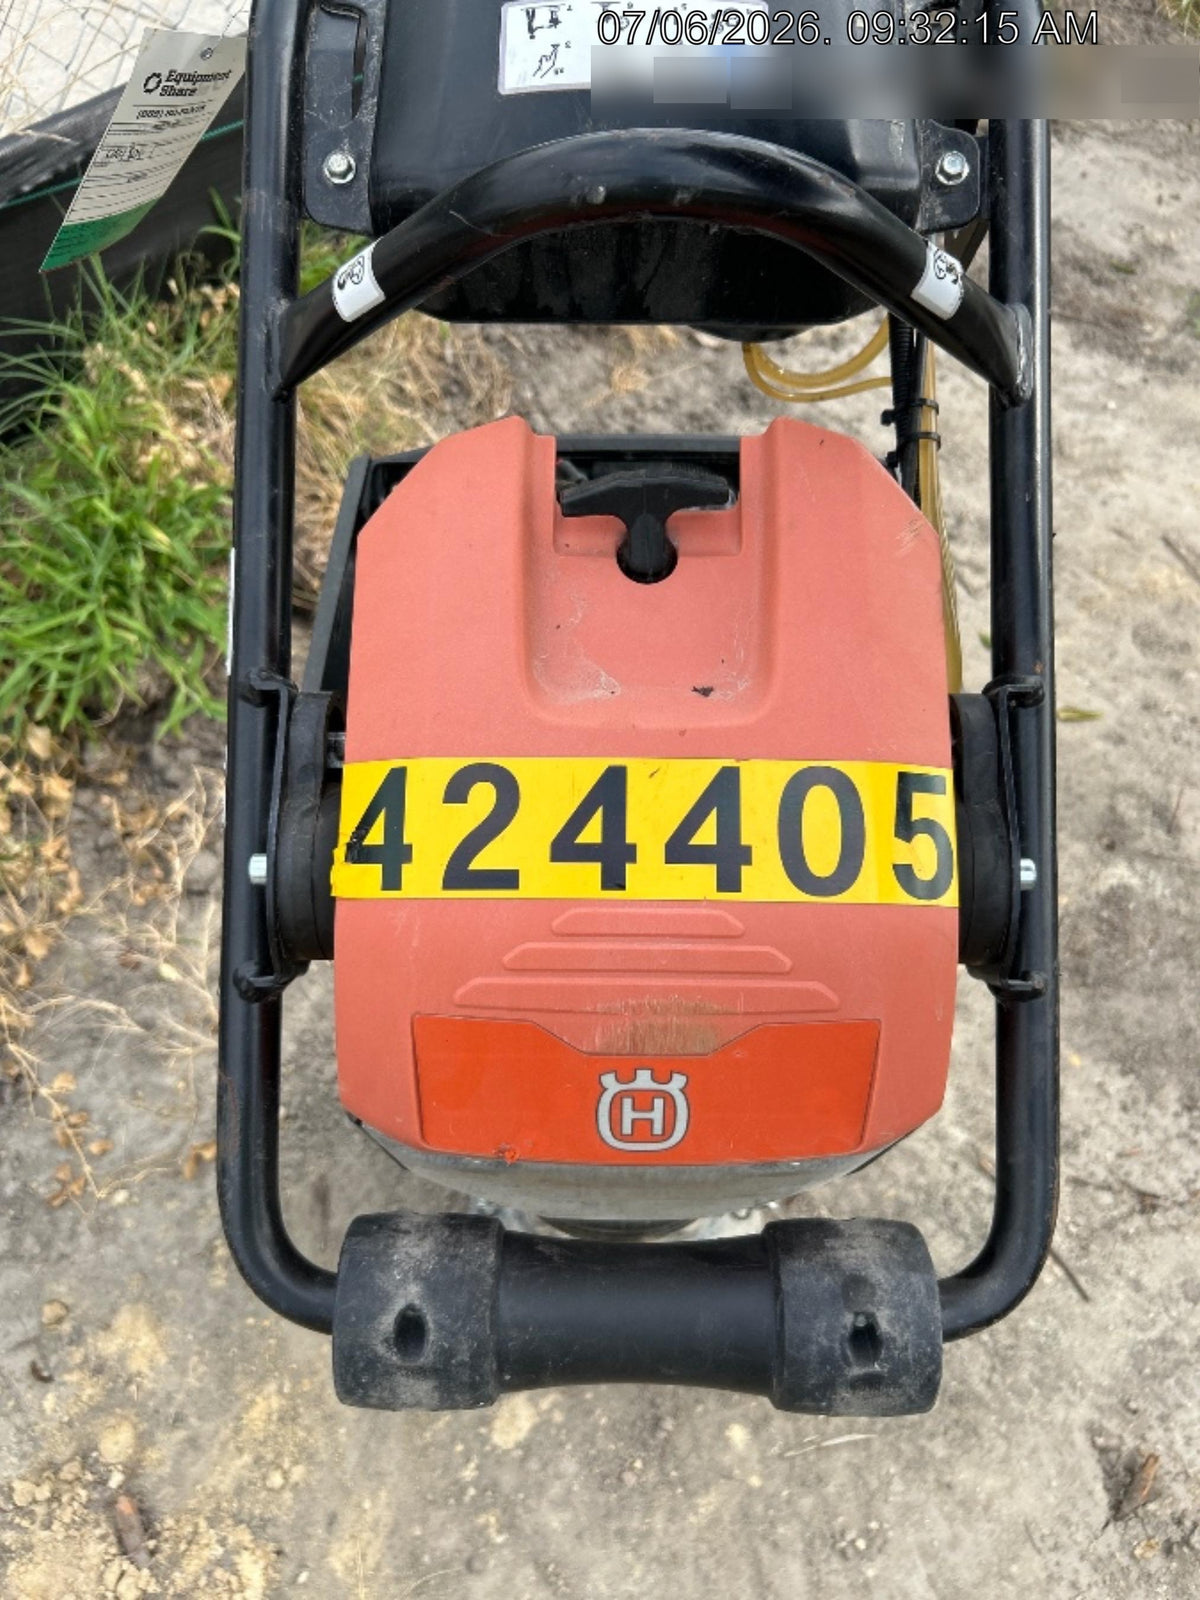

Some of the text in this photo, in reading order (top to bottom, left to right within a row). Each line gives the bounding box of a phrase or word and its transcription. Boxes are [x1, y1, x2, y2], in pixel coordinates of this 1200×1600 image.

[165, 69, 232, 85] Equipment
[159, 85, 198, 97] Share
[345, 762, 954, 900] 424405
